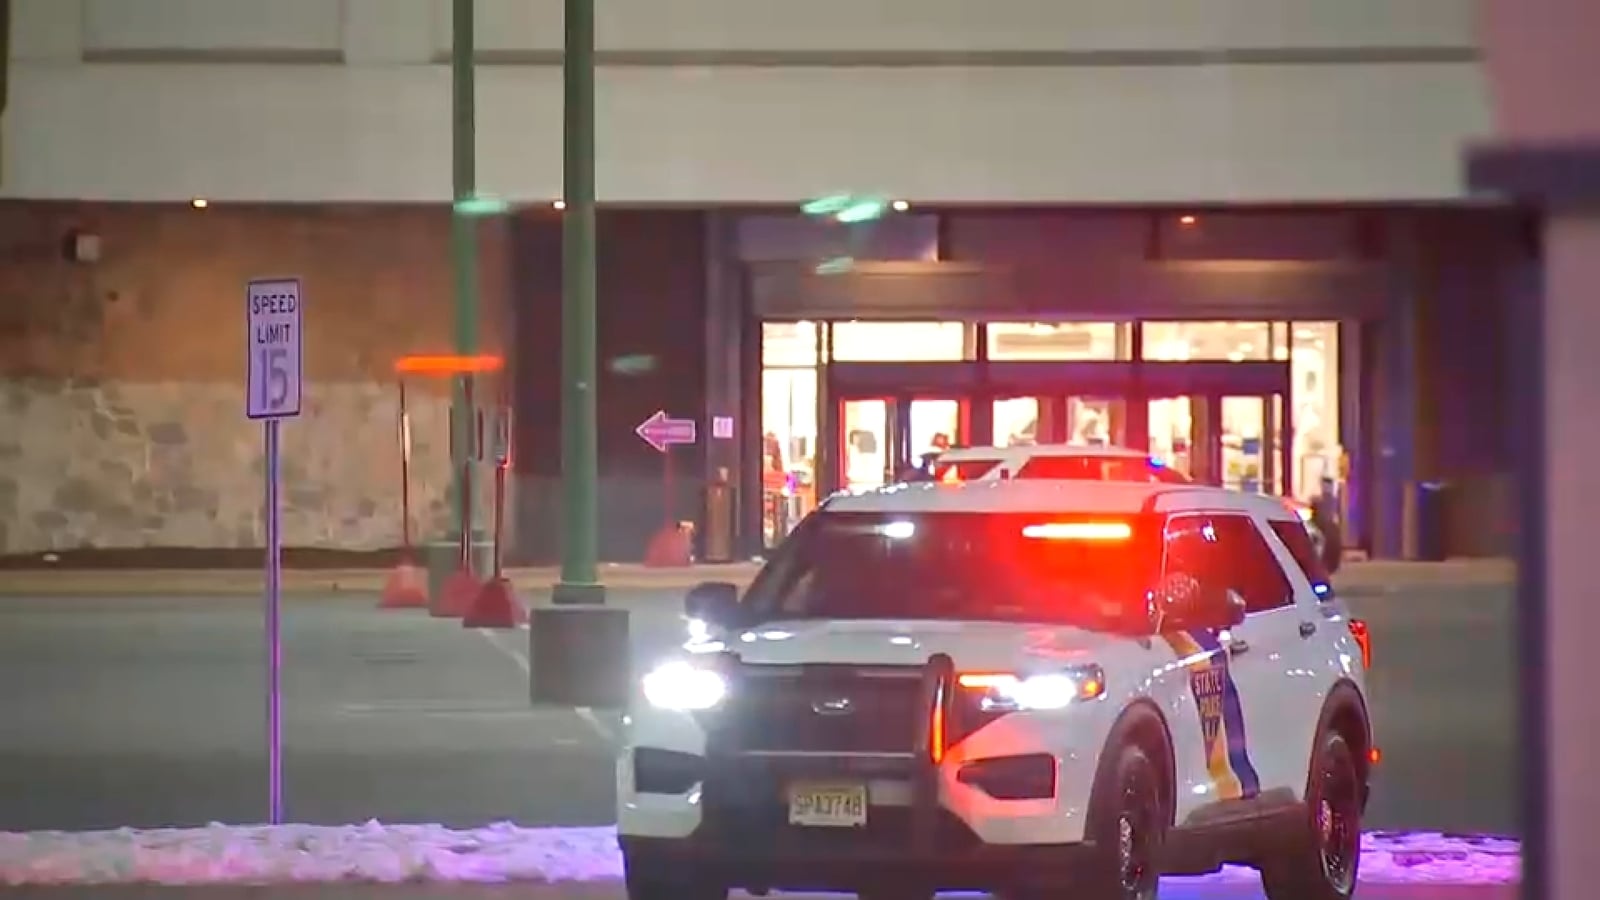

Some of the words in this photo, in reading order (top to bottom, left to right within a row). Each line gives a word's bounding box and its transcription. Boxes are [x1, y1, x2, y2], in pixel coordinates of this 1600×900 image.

[253, 294, 296, 314] SPEED
[257, 324, 290, 344] LIMIT
[258, 348, 288, 410] 15
[1194, 671, 1222, 696] STATE
